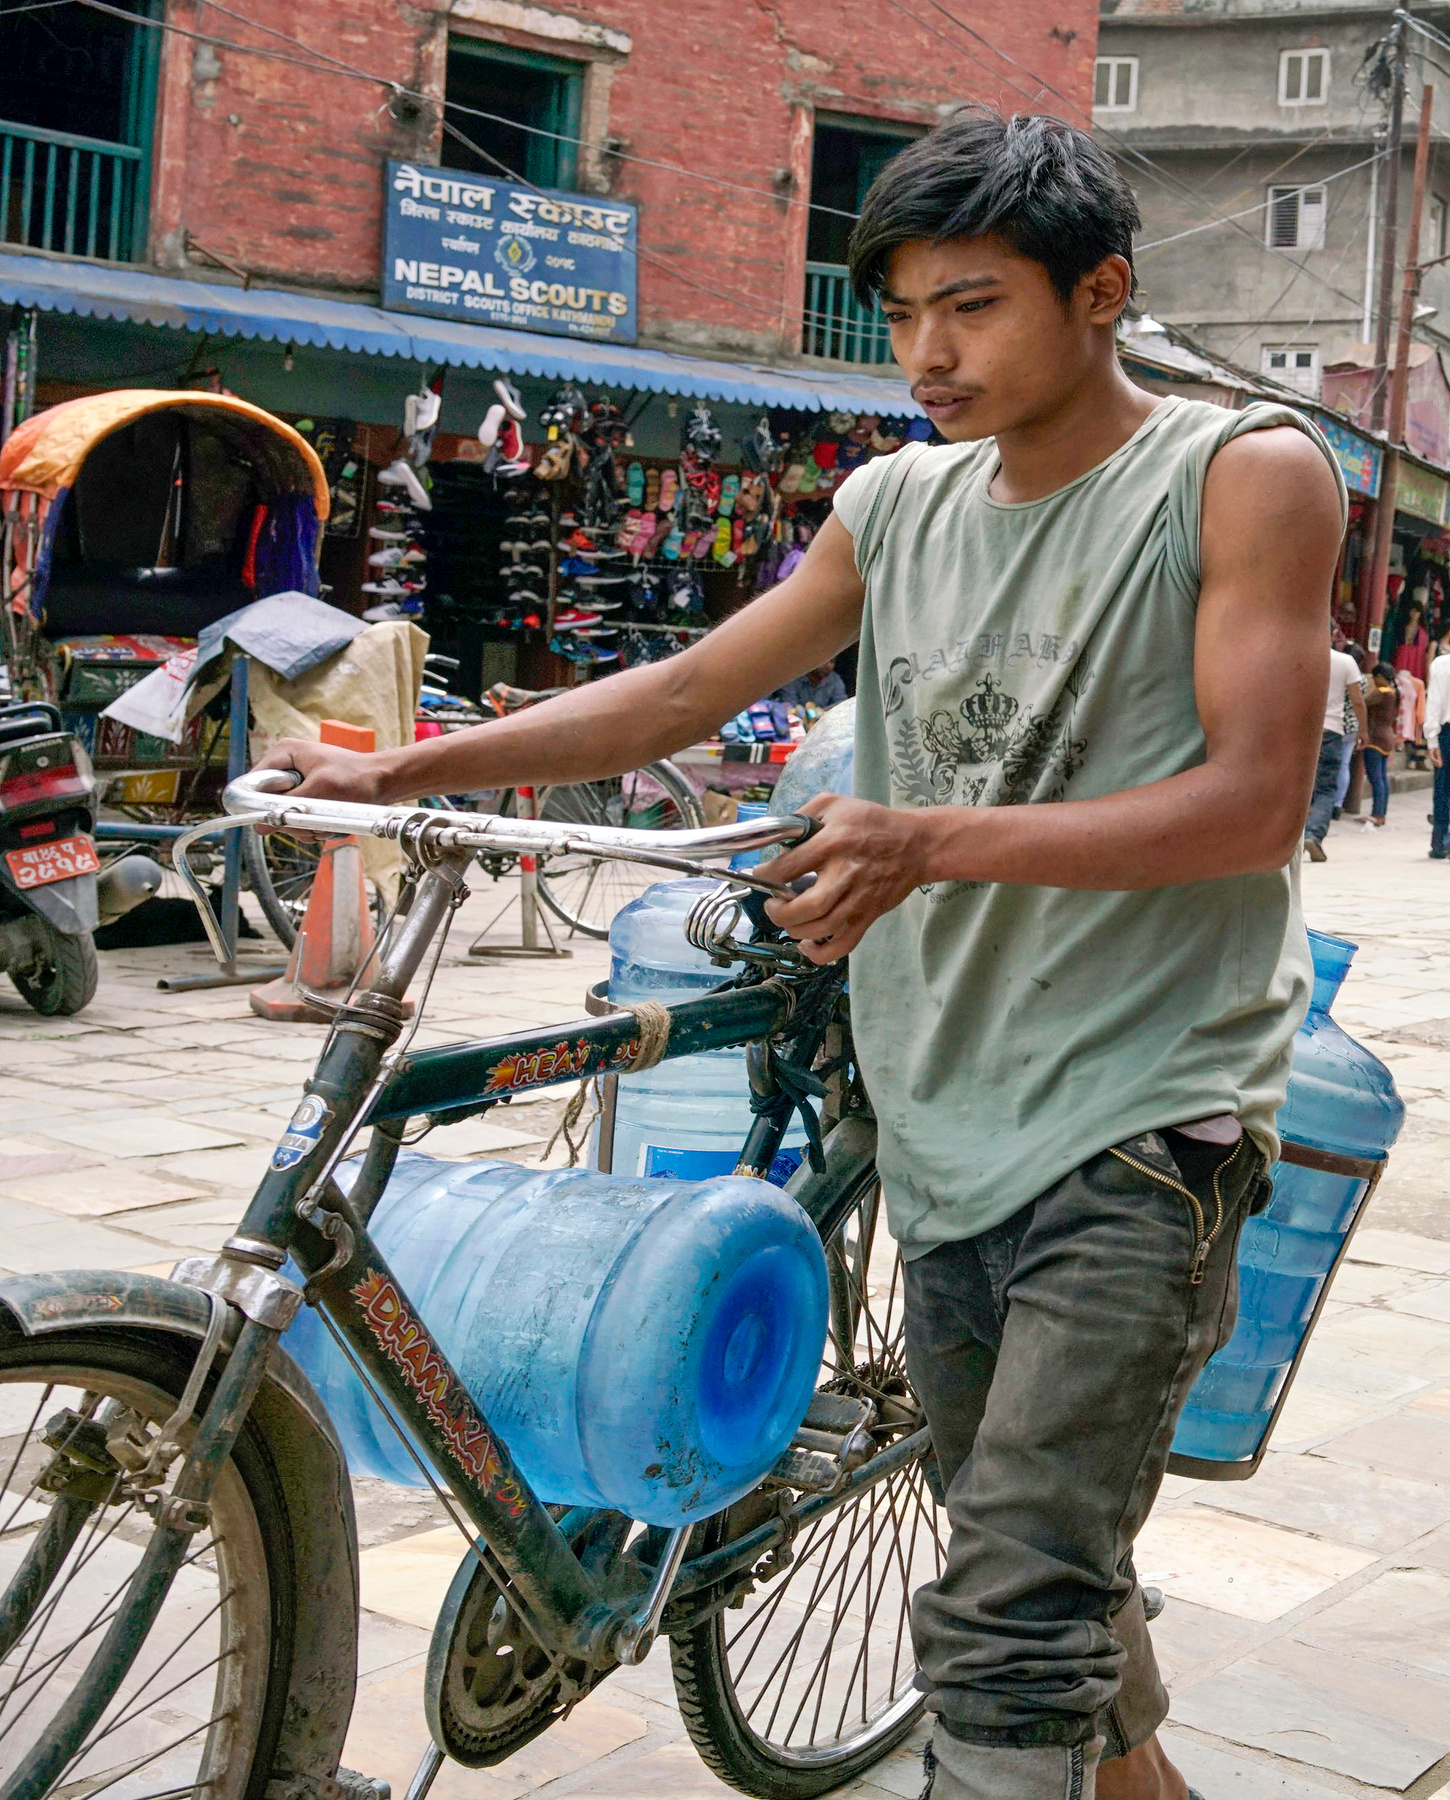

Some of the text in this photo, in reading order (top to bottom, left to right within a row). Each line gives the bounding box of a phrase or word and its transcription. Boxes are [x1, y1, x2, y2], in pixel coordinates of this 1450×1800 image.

[394, 164, 631, 235] नेपाल स्काउट
[394, 258, 628, 316] NEPAL SCOUTS
[406, 285, 460, 305] DISTRICT
[464, 295, 511, 314] SCOUTS
[512, 302, 550, 319] OFFICE
[512, 1043, 606, 1085] HEAV
